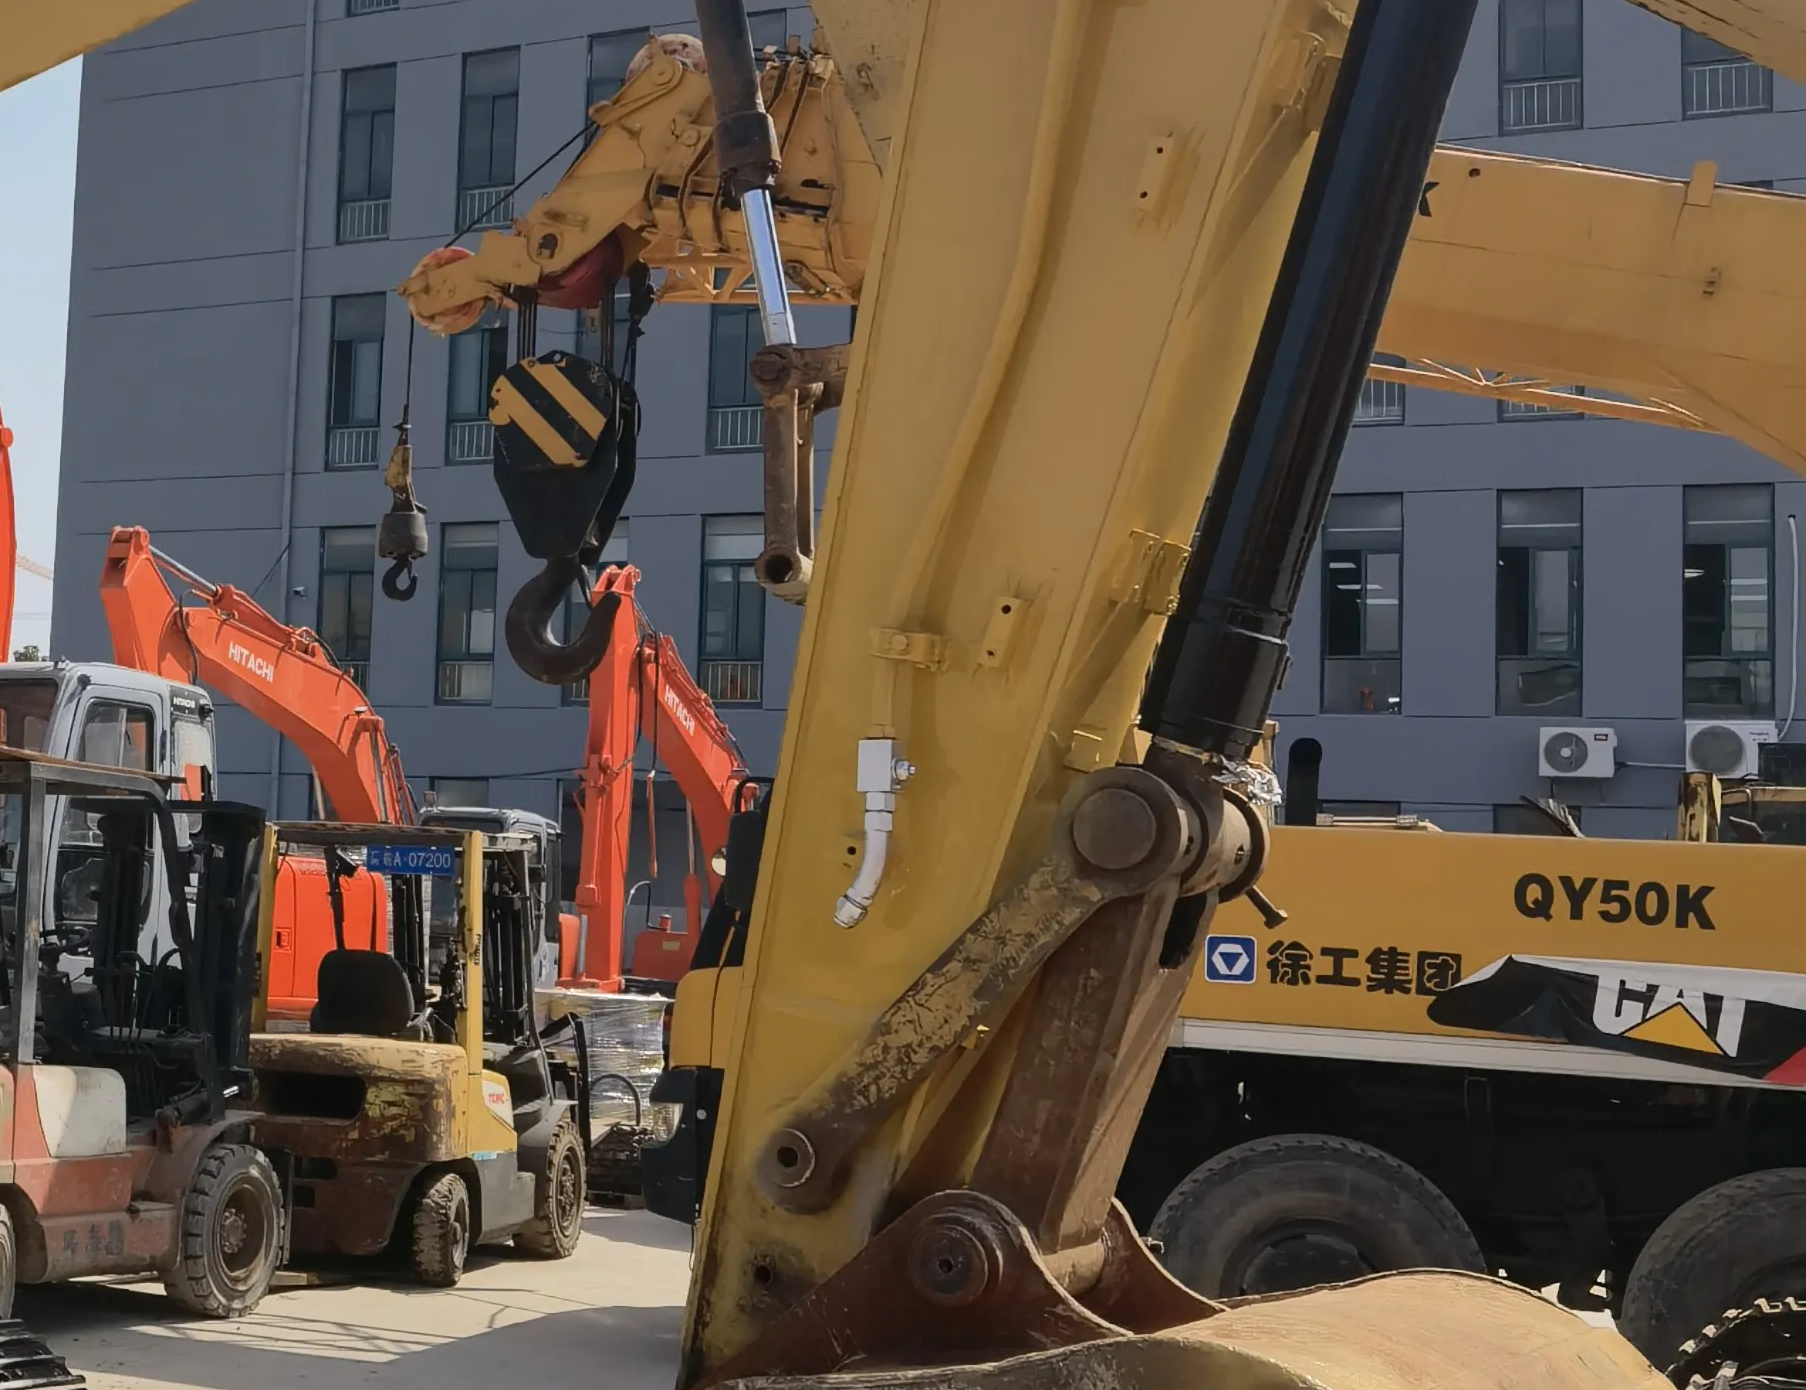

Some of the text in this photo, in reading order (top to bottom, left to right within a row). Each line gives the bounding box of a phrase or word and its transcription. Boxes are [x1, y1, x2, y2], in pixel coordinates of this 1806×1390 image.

[228, 641, 274, 683] HITACHI
[1513, 872, 1716, 931] QY50K
[1266, 939, 1462, 997] 徐工集团
[1592, 970, 1746, 1058] CAT
